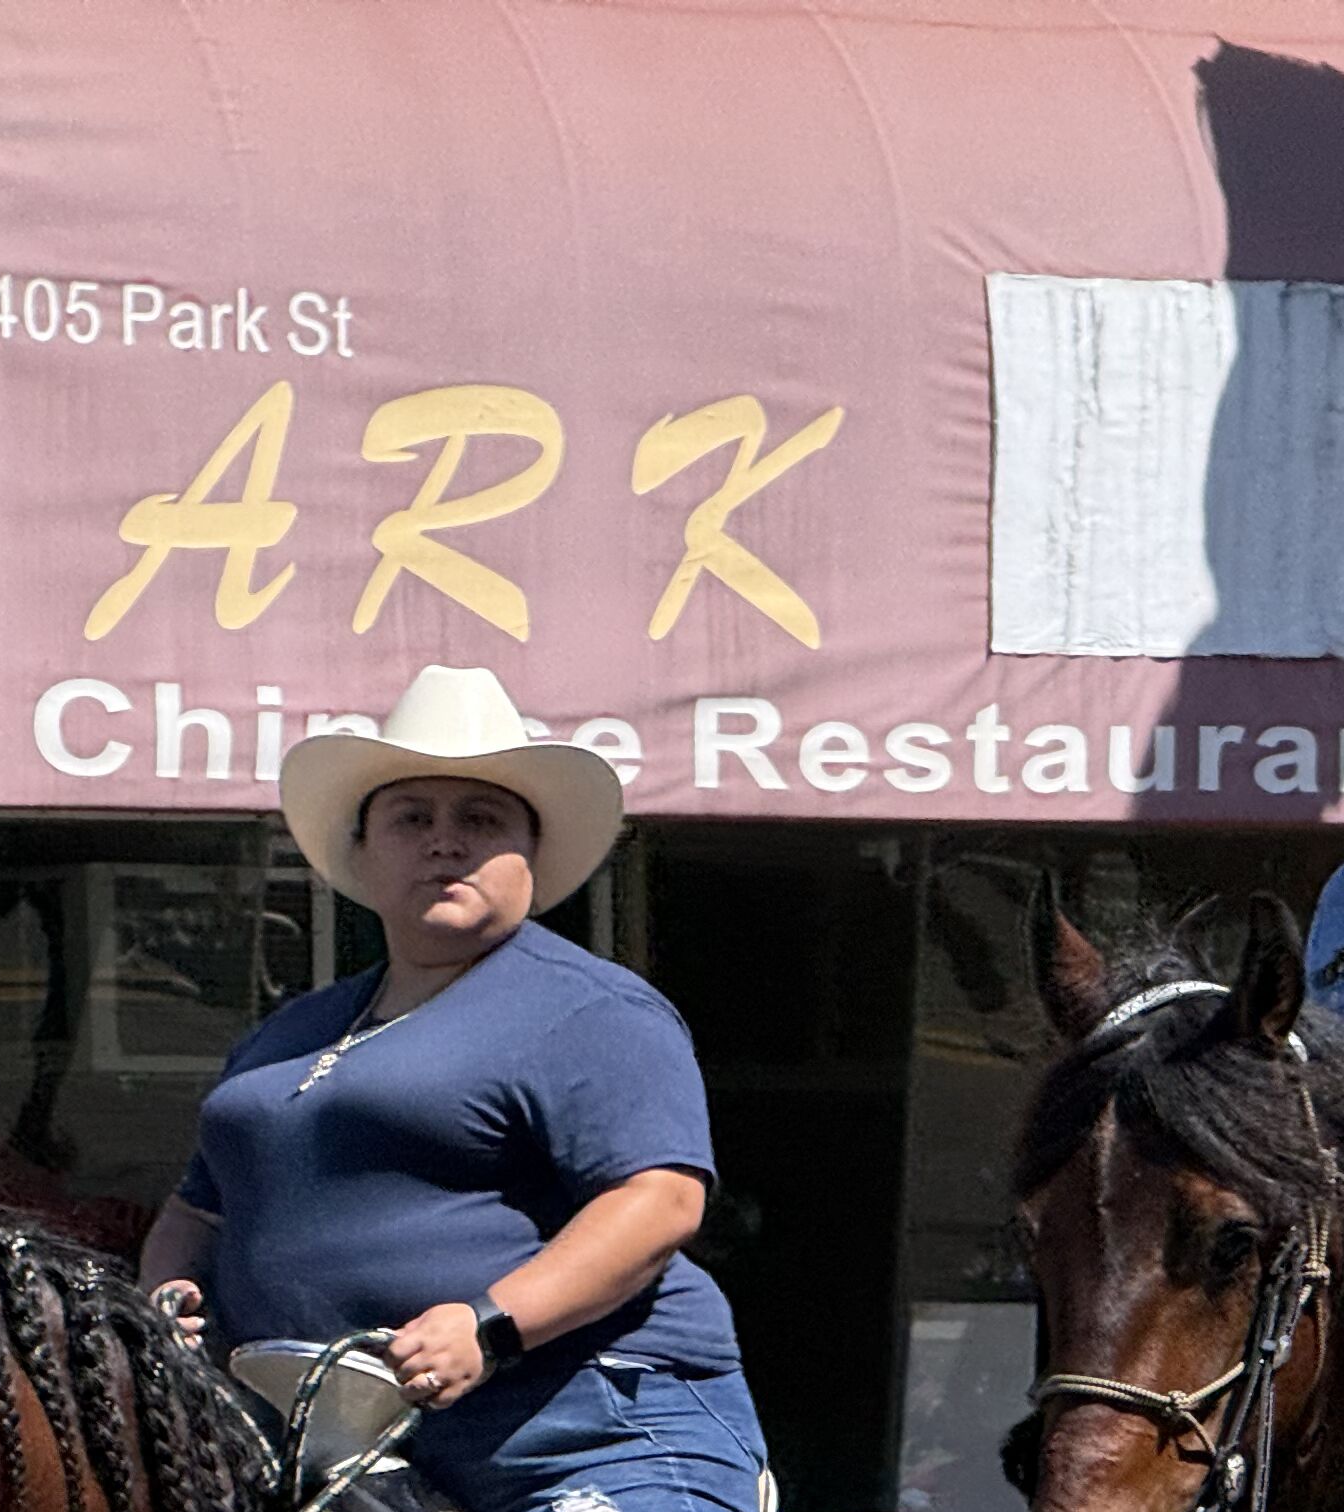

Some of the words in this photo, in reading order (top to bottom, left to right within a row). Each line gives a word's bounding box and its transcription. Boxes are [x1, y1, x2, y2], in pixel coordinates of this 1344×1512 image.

[122, 284, 270, 353] Park
[287, 291, 354, 357] St
[84, 381, 844, 650] ARK
[33, 678, 644, 786] Chie
